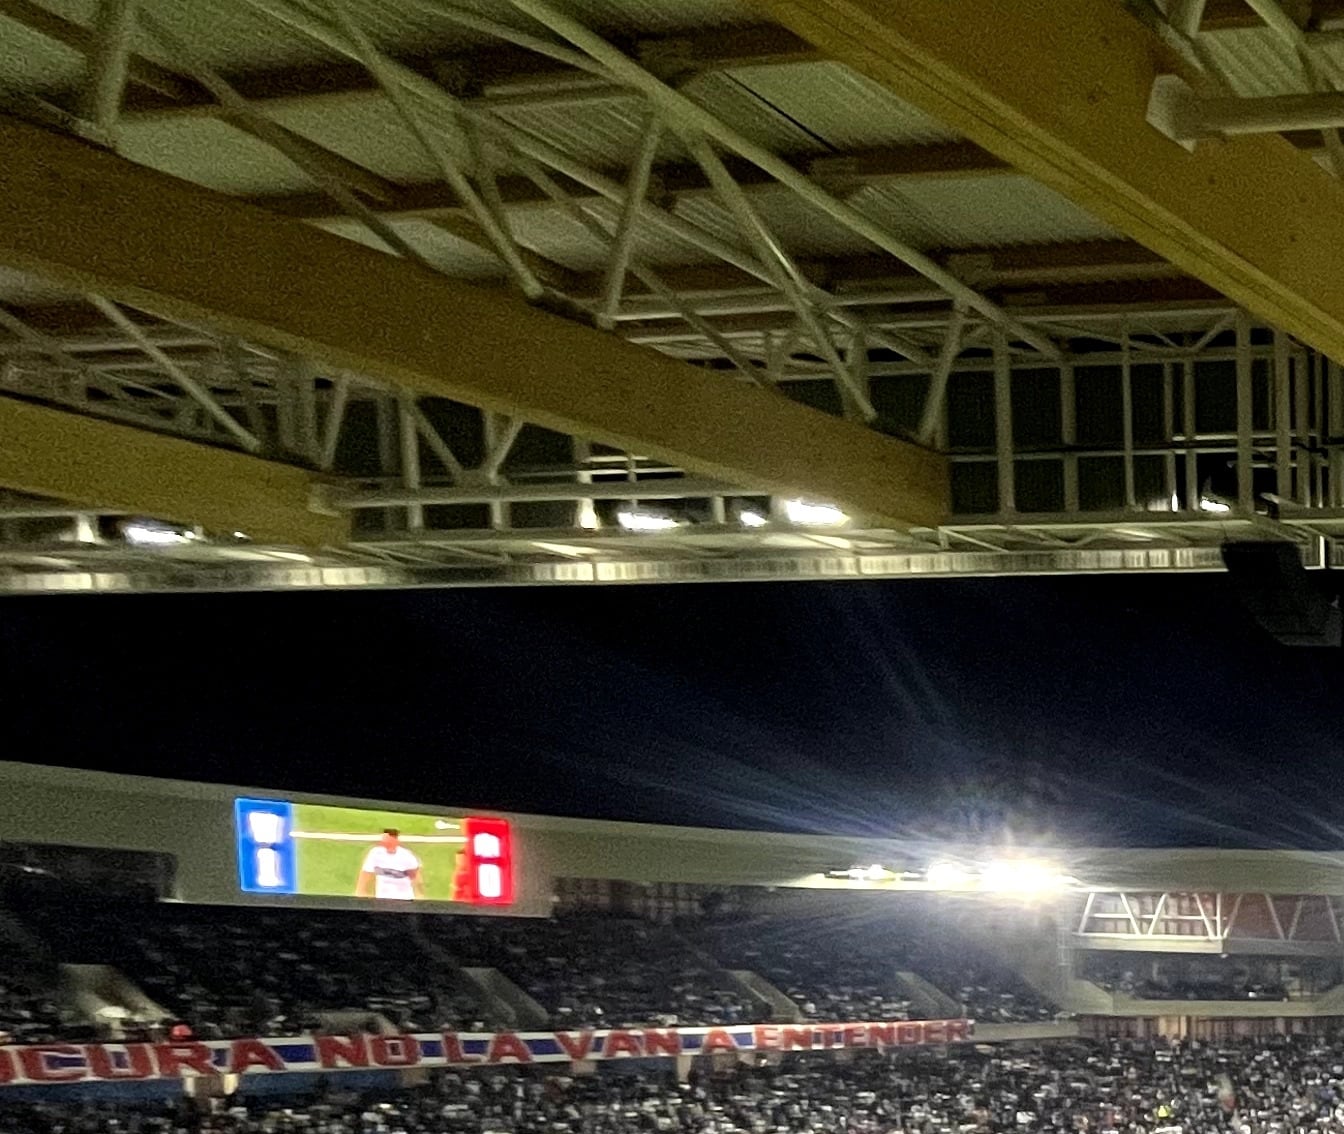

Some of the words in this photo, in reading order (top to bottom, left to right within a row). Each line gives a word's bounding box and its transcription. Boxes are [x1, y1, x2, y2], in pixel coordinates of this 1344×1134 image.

[0, 1037, 286, 1085] CURA
[315, 1033, 419, 1069] NO
[442, 1030, 532, 1064] LA
[554, 1028, 683, 1061] VAN
[703, 1029, 739, 1054] A
[754, 1019, 970, 1051] ENTENDER
